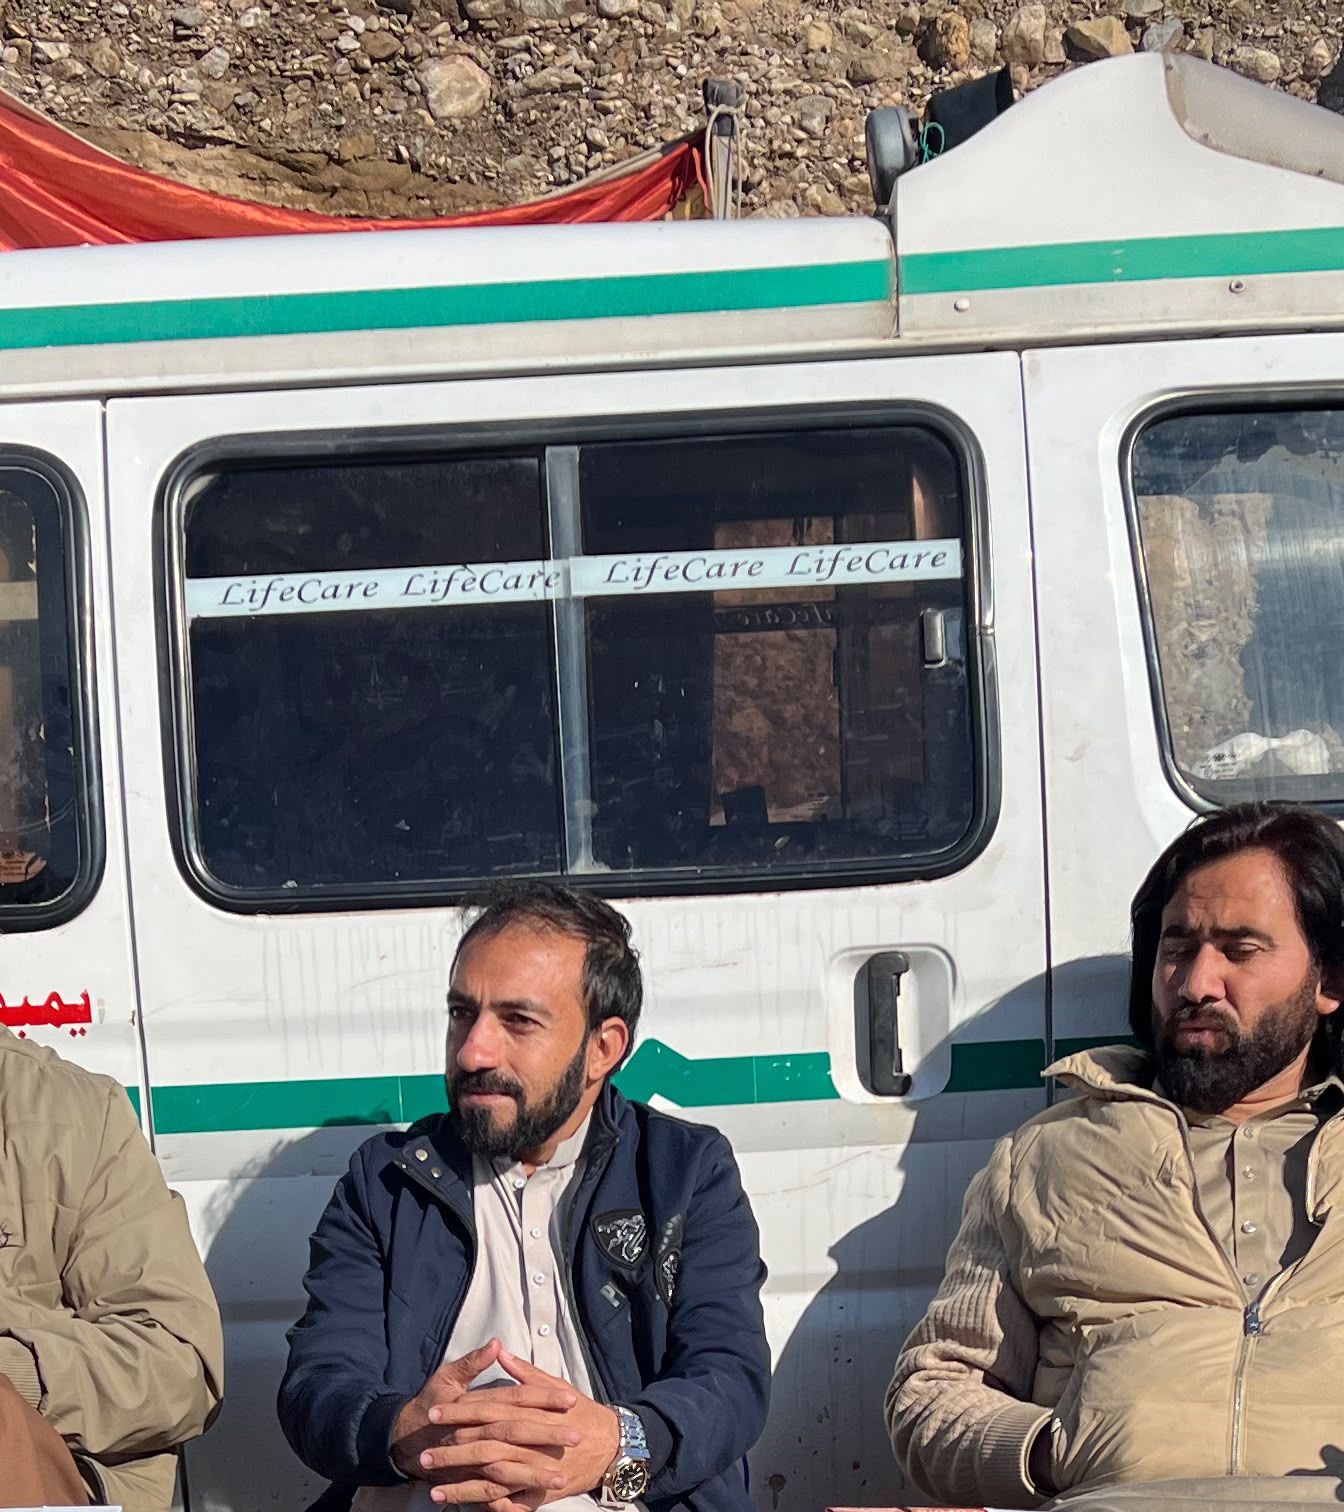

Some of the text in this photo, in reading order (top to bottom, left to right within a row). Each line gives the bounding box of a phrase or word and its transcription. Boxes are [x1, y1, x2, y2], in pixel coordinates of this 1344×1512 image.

[219, 564, 561, 612] LifeCare LifeCare
[603, 547, 948, 591] LifeCare LifeCare
